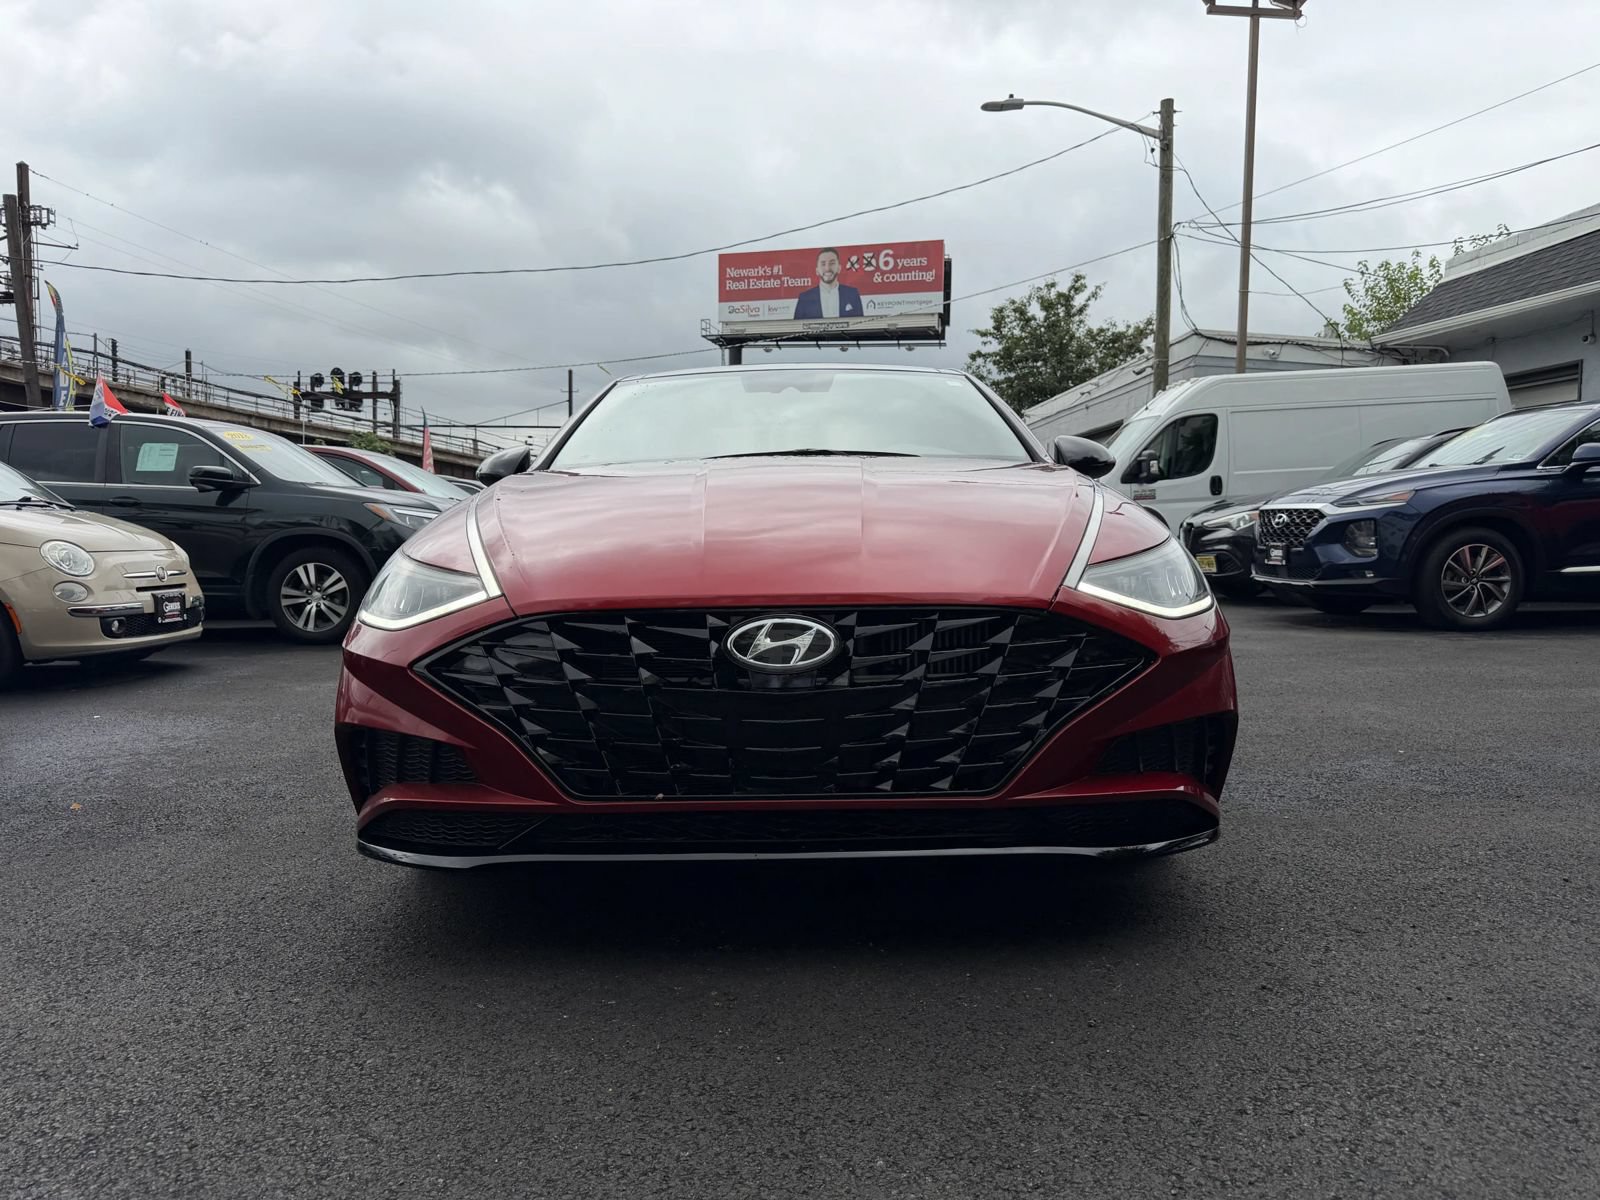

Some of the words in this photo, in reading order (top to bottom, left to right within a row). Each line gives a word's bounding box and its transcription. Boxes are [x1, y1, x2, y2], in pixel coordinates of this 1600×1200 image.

[878, 249, 895, 271] 6
[896, 257, 928, 269] years
[726, 266, 772, 278] Newark's
[772, 264, 783, 276] #1
[872, 272, 882, 283] &
[883, 269, 936, 282] counting!
[726, 279, 748, 290] Real
[749, 278, 781, 289] Estate
[781, 276, 812, 287] Team
